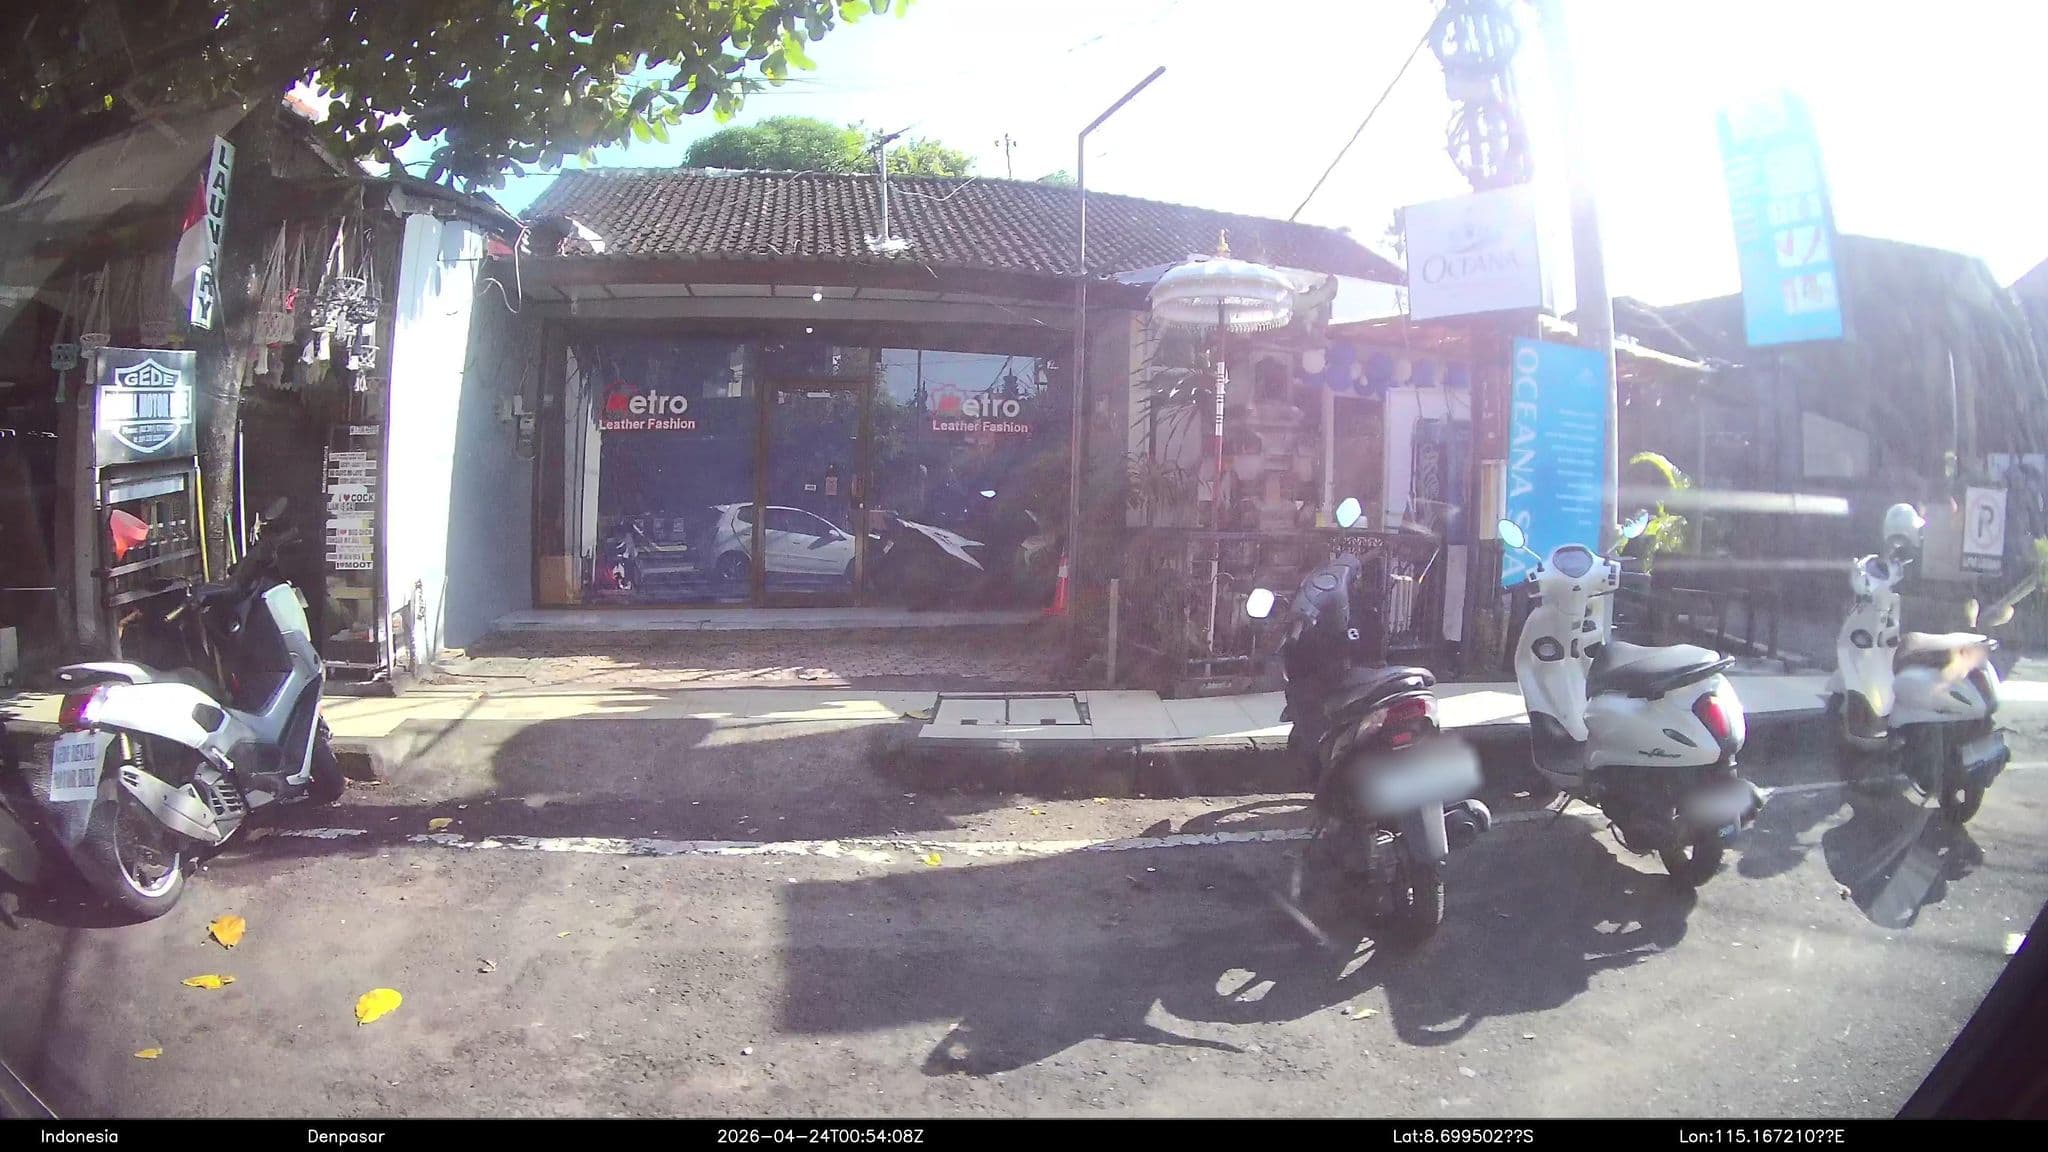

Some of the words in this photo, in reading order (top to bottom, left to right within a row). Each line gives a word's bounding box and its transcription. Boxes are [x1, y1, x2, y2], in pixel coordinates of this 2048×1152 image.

[198, 145, 230, 320] LAUNRY
[124, 366, 176, 387] GEDE
[599, 418, 645, 430] Leather
[647, 418, 696, 430] Fashion
[932, 420, 980, 432] Leather
[983, 421, 1029, 433] Fashion
[1509, 346, 1539, 498] OCEANA
[351, 494, 374, 502] COCK
[1501, 509, 1531, 580] SA
